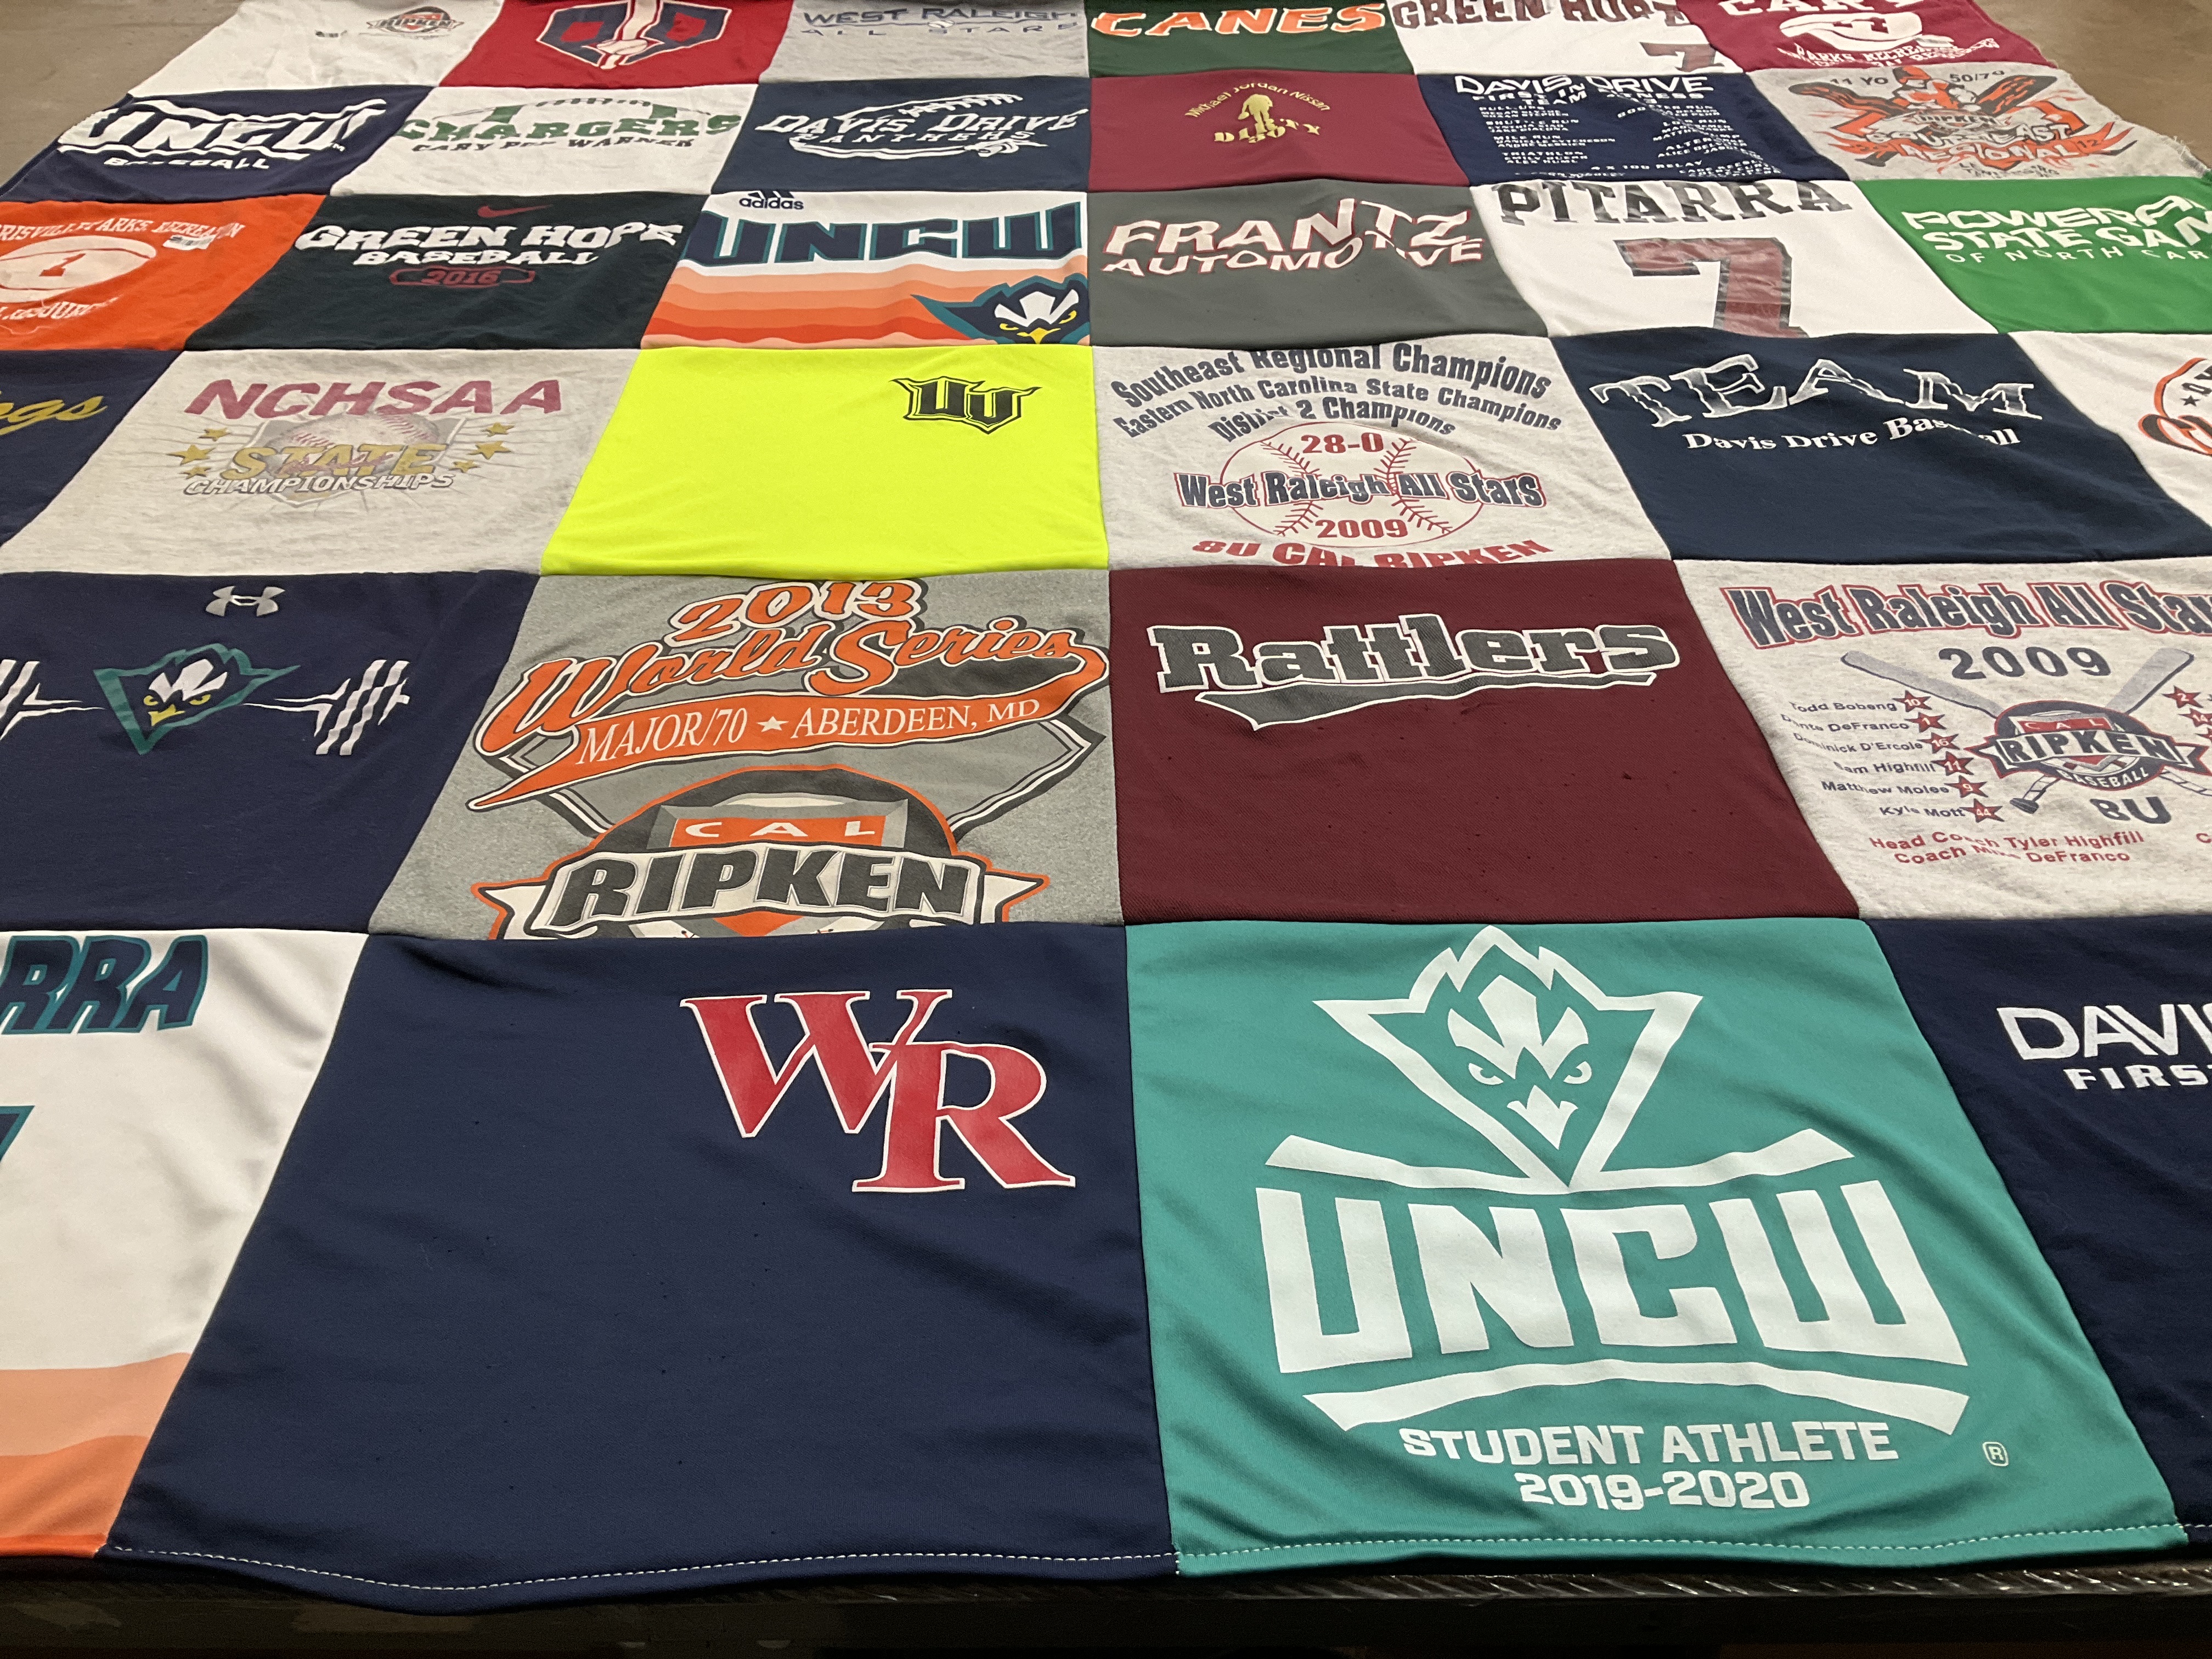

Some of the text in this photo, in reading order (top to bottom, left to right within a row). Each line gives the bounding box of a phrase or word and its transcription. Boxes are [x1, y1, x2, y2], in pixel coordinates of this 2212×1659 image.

[804, 8, 909, 26] WEST
[1091, 3, 1386, 37] CANES
[1454, 75, 1714, 95] DAVIS DRIVE
[1859, 77, 1888, 86] YO
[1290, 91, 1331, 111] Nissan
[396, 114, 742, 142] CHARGERS
[754, 109, 1090, 134] DAVIS DRIVE
[738, 196, 804, 211] adidas
[1491, 179, 1853, 226] PITARRA
[1901, 195, 2208, 228] POWERA
[295, 221, 684, 251] GREEN HOPE
[684, 201, 1082, 267] UNCW
[1103, 198, 1470, 255] FRANTZ
[1922, 227, 2093, 251] STATE
[353, 250, 600, 266] BASEBALL
[1945, 252, 1986, 264] OF
[2005, 246, 2124, 261] NORTH
[1613, 236, 1810, 338] 7
[1110, 342, 1553, 409] Southeast Regional Champions
[184, 379, 562, 419] NCHSAA
[1589, 353, 2044, 428] TEAM
[1112, 375, 1562, 439] Eastern North Carolina State Champions
[1296, 399, 1318, 421] 2
[1322, 396, 1458, 437] Champions
[1300, 431, 1385, 454] 28-0
[1683, 432, 1774, 451] Davis
[1783, 429, 1878, 450] Drive
[219, 443, 449, 481] STATE
[184, 472, 456, 495] CHAMPIONSHIPS
[1173, 469, 1547, 509] West Raleigh All Stars
[1316, 518, 1409, 539] 2009
[1192, 540, 1262, 557] 8U
[1374, 539, 1554, 569] RIPKEN
[664, 578, 927, 648] 2013
[1721, 585, 1864, 650] West
[1841, 583, 2049, 640] Raleigh
[2027, 582, 2130, 631] All
[1147, 613, 1680, 693] Rattlers
[1938, 646, 2112, 680] 2009
[474, 617, 1093, 756] World Series
[2177, 692, 2190, 702] 2
[1788, 701, 1829, 713] Todd
[1904, 698, 1921, 707] 10
[576, 698, 1041, 766] MAJOR/70 ABERDEEN, MD
[1828, 722, 1910, 732] DeFranco
[1922, 716, 1931, 725] 1
[2024, 719, 2104, 730] CAL
[1859, 742, 1923, 752] D'Ercole
[1931, 738, 1949, 747] 16
[2000, 730, 2181, 763] RIPKEN
[1872, 762, 1937, 774] Highfill
[1943, 761, 1961, 771] 11
[2058, 768, 2149, 788] BASEBALL
[1820, 780, 1892, 794] Matthew
[1962, 783, 1973, 792] 9
[1924, 808, 1966, 817] Mott
[1976, 808, 1991, 816] 44
[2090, 796, 2172, 824] 8U
[685, 819, 876, 839] CAL
[1869, 835, 1927, 850] Head
[2003, 836, 2059, 850] Tyler
[2064, 831, 2145, 850] Highfill
[1894, 847, 1967, 865] Coach
[2025, 851, 2131, 863] DeFranco
[547, 845, 969, 928] RIPKEN
[1996, 1003, 2212, 1060] DAVI
[680, 989, 1076, 1193] WR
[2063, 1064, 2212, 1090] FIRS
[1255, 1179, 1970, 1374] UNCW
[1400, 1421, 1900, 1466] STUDENT ATHLETE
[1515, 1470, 1811, 1512] 2019-2020
